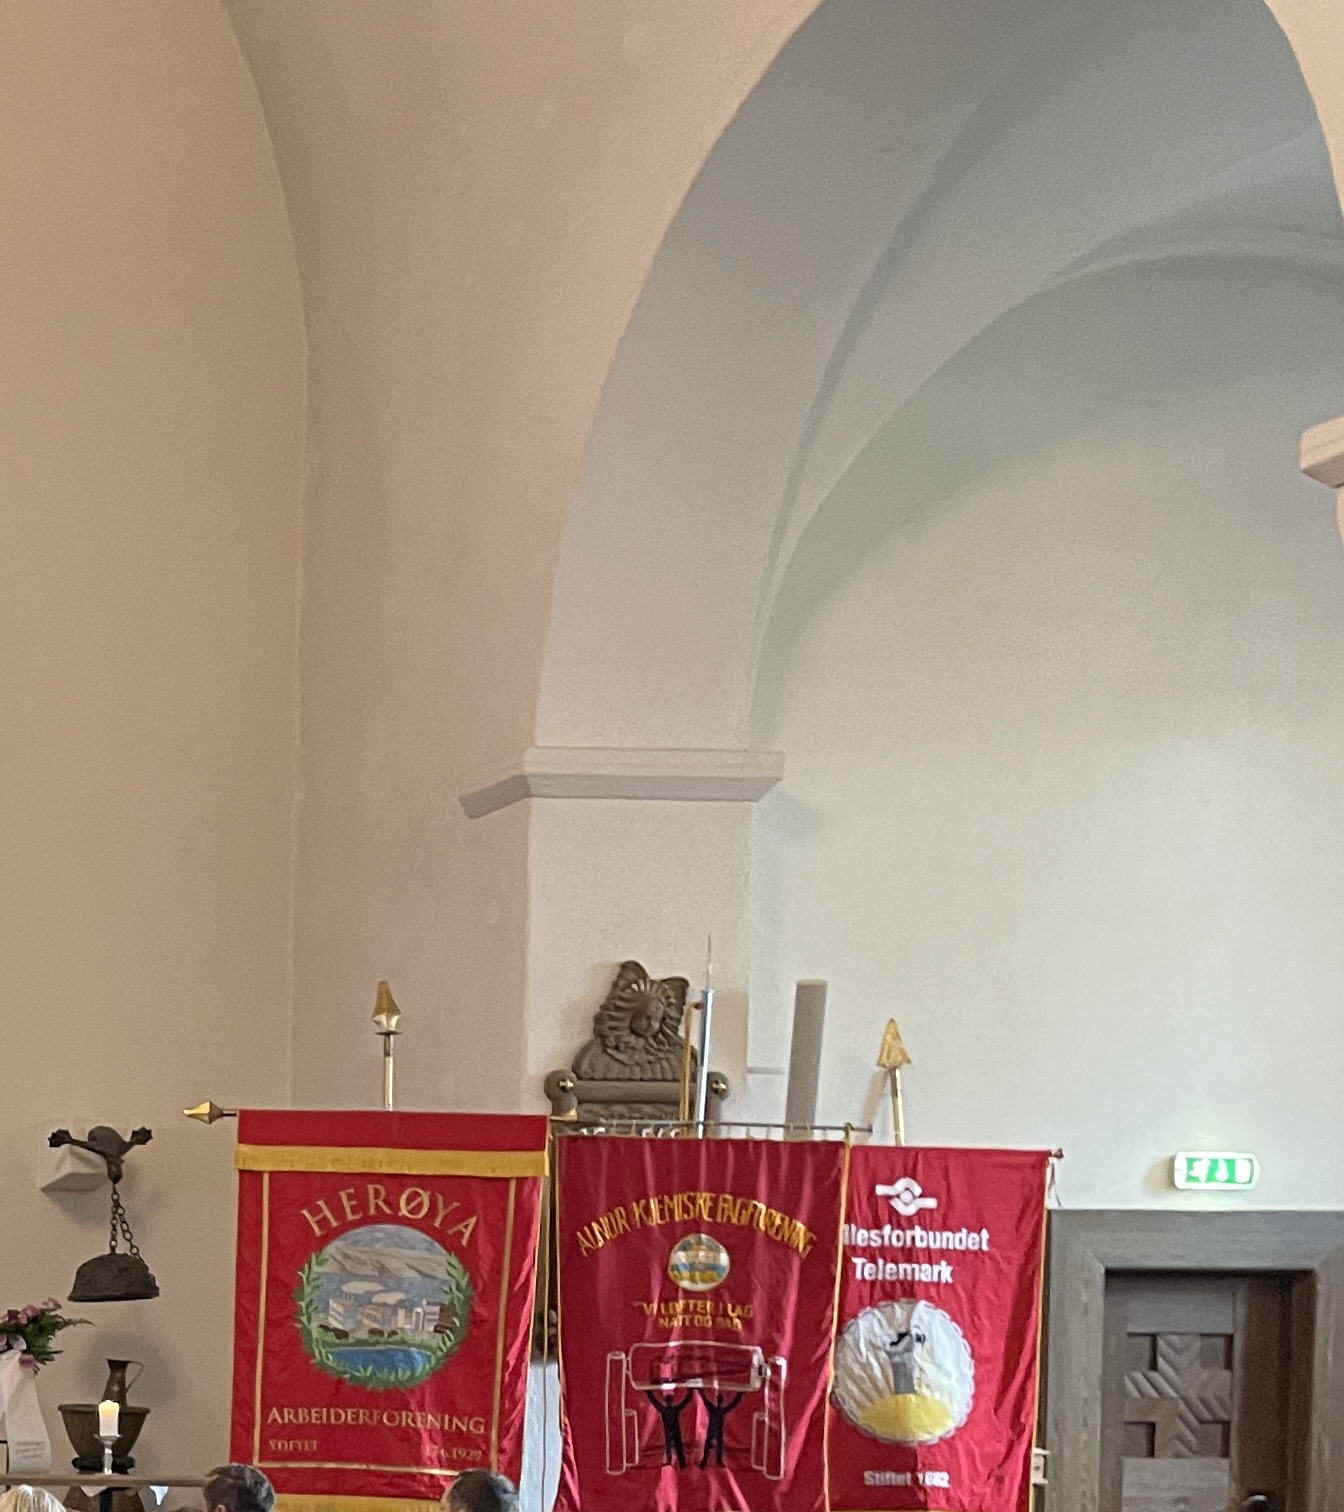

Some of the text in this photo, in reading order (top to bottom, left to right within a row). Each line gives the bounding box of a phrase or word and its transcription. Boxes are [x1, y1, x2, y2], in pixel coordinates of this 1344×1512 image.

[300, 1184, 479, 1248] HERØYA
[843, 1224, 989, 1251] llesforbundet
[851, 1257, 954, 1284] Telemark
[267, 1406, 486, 1435] ARBEIDERFORENING
